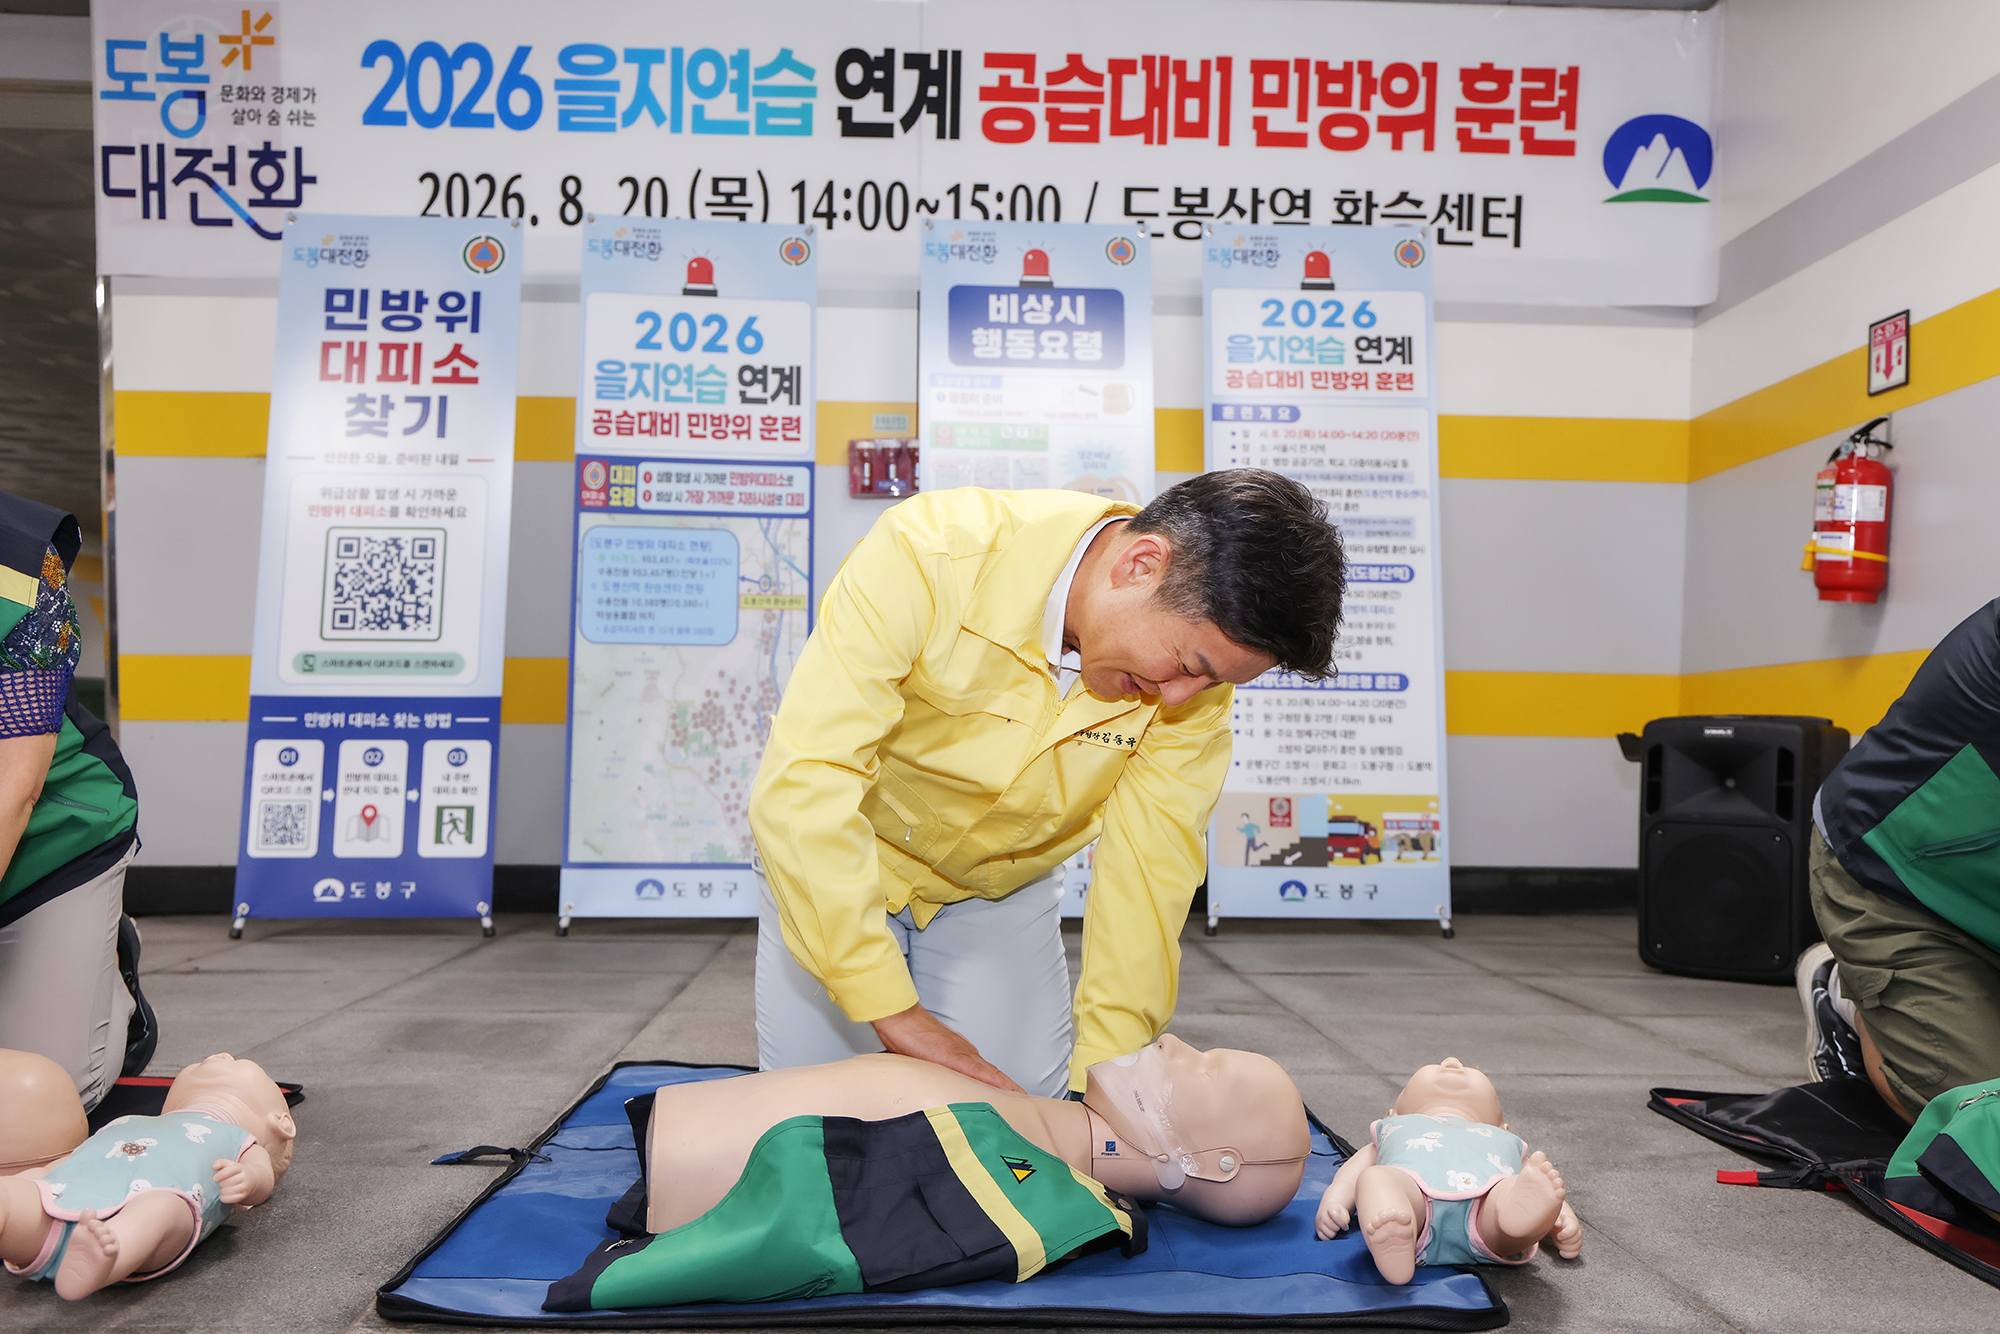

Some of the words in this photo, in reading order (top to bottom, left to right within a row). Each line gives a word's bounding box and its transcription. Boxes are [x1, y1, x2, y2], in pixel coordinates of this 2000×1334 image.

[100, 32, 210, 139] 도봉
[220, 85, 266, 103] 문화와
[271, 86, 317, 104] 경제가
[360, 39, 543, 132] 2026
[554, 42, 818, 137] 을지연습
[834, 46, 962, 141] 연계
[978, 51, 1233, 147] 공습대비
[1250, 57, 1439, 154] 민방위
[1455, 62, 1581, 157] 훈련
[231, 109, 263, 126] 살아
[266, 110, 281, 126] 숨
[286, 110, 317, 127] 쉬는
[101, 140, 317, 240] 대전환
[419, 172, 538, 226] 2026.
[618, 168, 770, 222] 20(목)
[791, 179, 1062, 231] 14:00~15:00
[1084, 181, 1098, 223] /
[323, 288, 482, 333] 민방위
[988, 293, 1086, 326] 비상시
[1260, 298, 1377, 328] 2026
[635, 310, 764, 355] 2026
[971, 327, 1103, 362] 행동요령
[1225, 333, 1346, 365] 을지연습
[1355, 335, 1413, 365] 연계
[319, 341, 479, 385] 대피소
[594, 359, 728, 405] 을지연습
[738, 364, 801, 406] 연계
[1225, 369, 1304, 389] 공습대비
[1310, 370, 1369, 390] 민방위
[1375, 371, 1414, 391] 훈련
[345, 393, 448, 439] 찾기
[592, 408, 680, 438] 공습대비
[687, 412, 751, 441] 민방위
[759, 415, 801, 442] 훈련
[396, 453, 432, 466] 준비된
[435, 453, 460, 466] 내일
[610, 465, 636, 485] 대피
[320, 487, 371, 501] 위급상황
[375, 487, 400, 501] 발생
[404, 488, 416, 501] 시
[420, 488, 458, 501] 가까운
[609, 486, 636, 507] 요령
[308, 504, 346, 518] 민방위
[349, 505, 399, 518] 대피소를
[405, 506, 468, 519] 확인하세요
[304, 712, 346, 729] 민방위
[348, 712, 390, 729] 대피소
[393, 712, 422, 729] 찾는
[424, 712, 452, 729] 방법
[280, 751, 297, 764] 01
[365, 751, 382, 764] 02
[449, 751, 467, 764] 03
[349, 881, 418, 900] 도봉구
[672, 881, 738, 898] 도봉구
[1314, 884, 1379, 900] 도봉구
